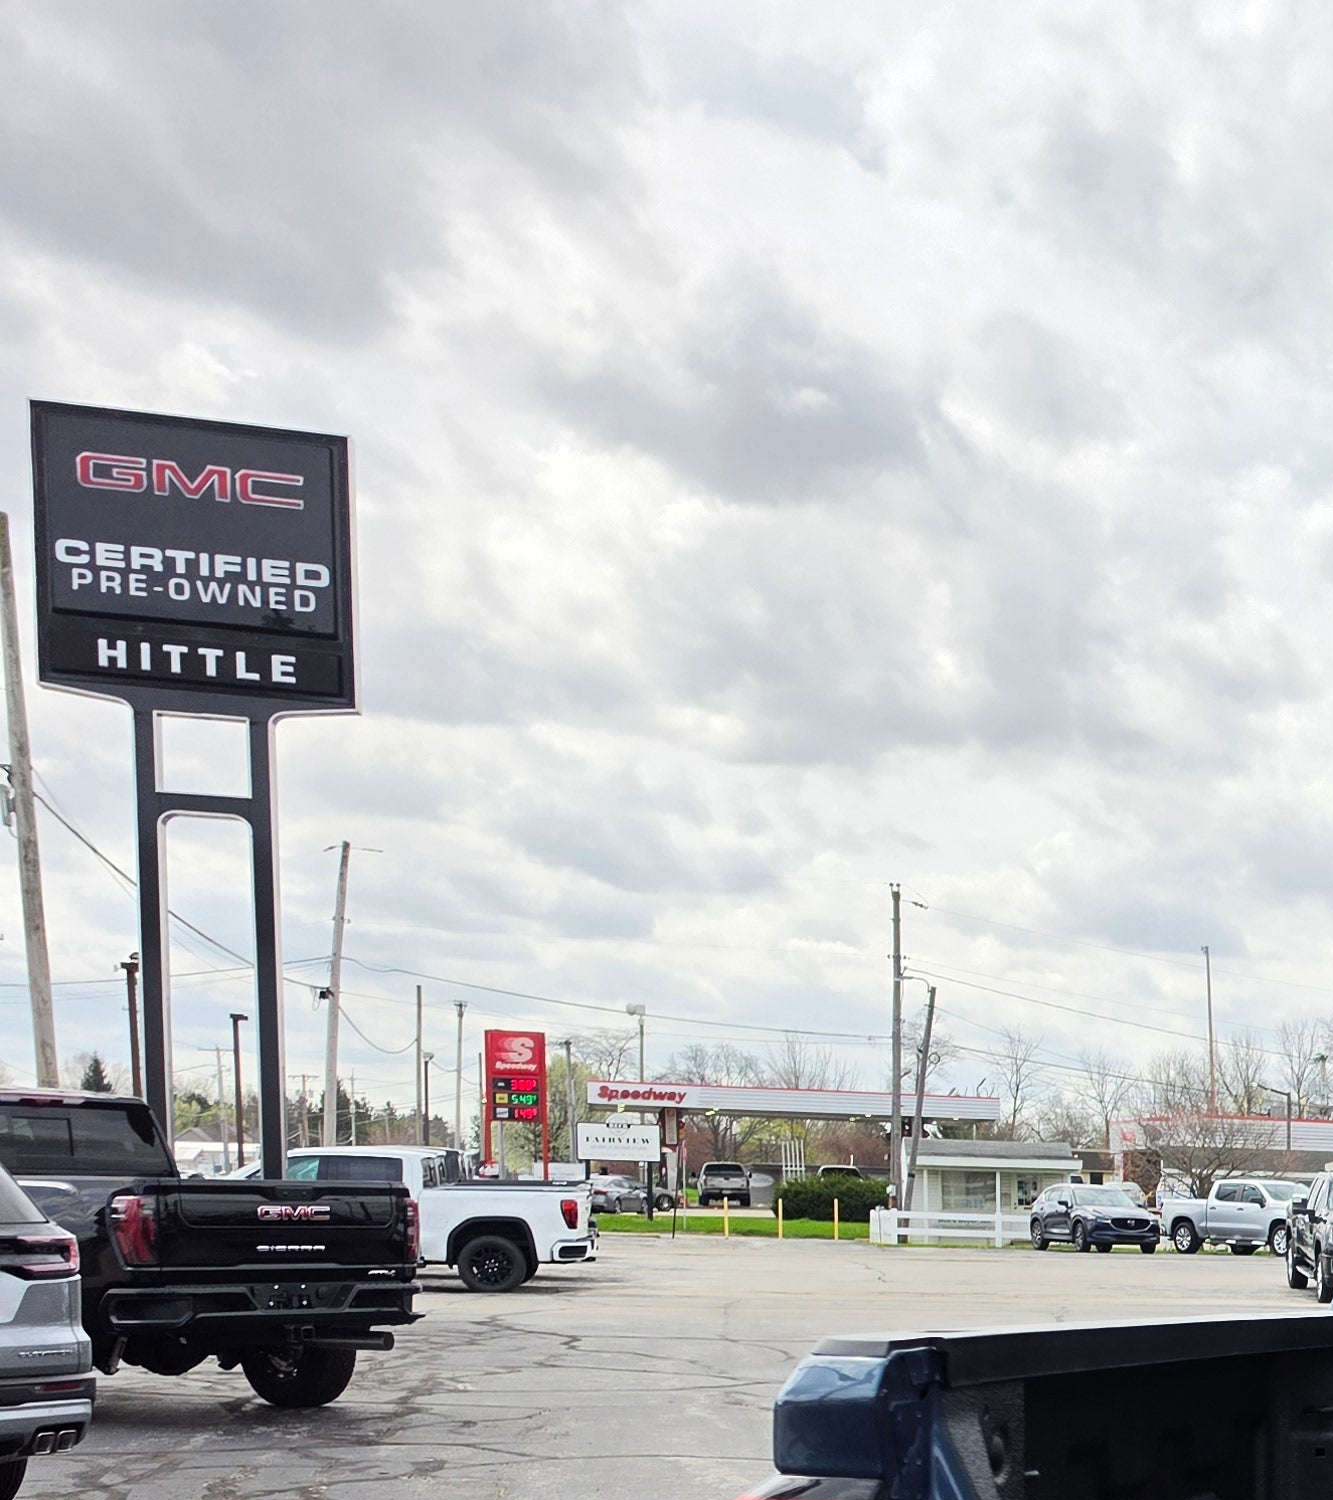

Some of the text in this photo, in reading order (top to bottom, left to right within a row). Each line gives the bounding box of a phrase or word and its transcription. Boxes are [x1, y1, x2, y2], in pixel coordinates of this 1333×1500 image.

[76, 451, 304, 510] GMC
[55, 538, 330, 588] CERTIFIED
[71, 567, 316, 612] PRE-OWNED
[97, 638, 296, 684] HITTLE
[495, 1061, 537, 1071] Speedway
[597, 1085, 687, 1104] Speedway
[257, 1205, 330, 1221] GMC
